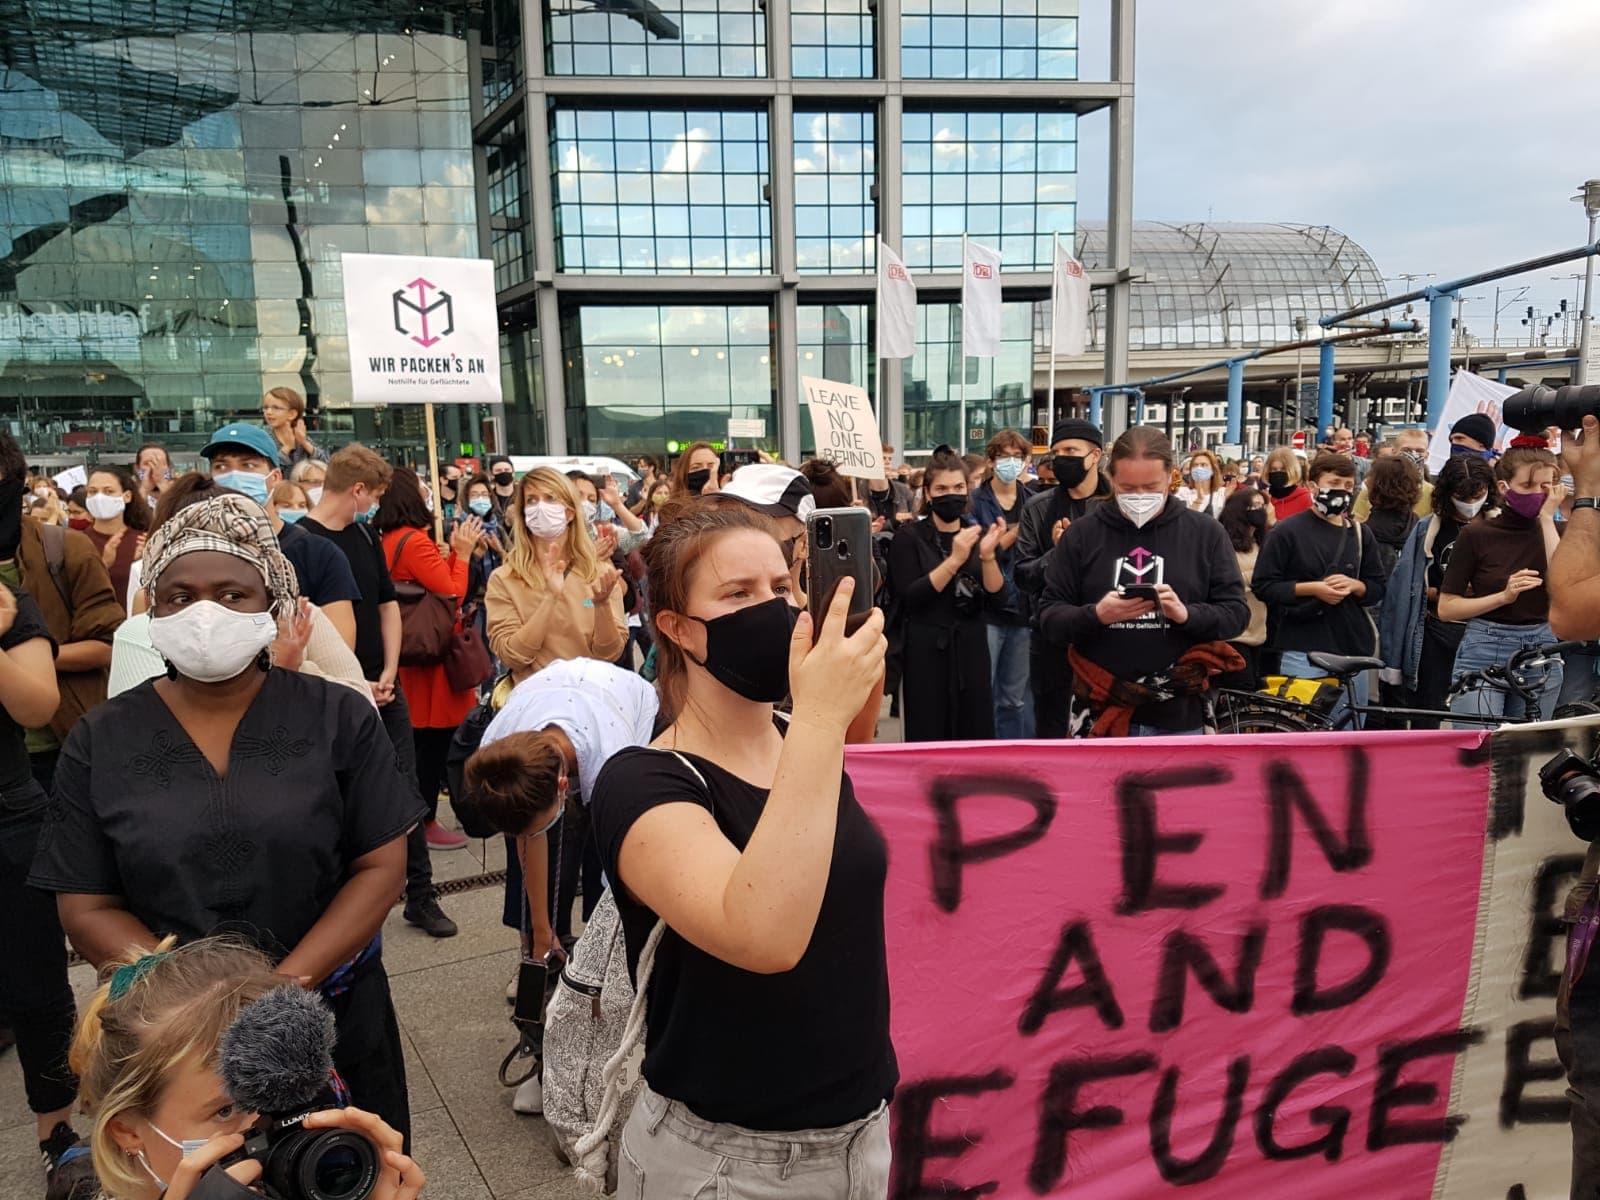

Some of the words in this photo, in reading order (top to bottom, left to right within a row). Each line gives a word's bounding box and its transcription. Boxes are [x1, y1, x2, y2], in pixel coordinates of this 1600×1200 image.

[889, 265, 906, 279] DB
[974, 264, 991, 278] DB
[369, 357, 395, 373] WIR
[400, 353, 463, 373] PACKEN'S
[468, 358, 485, 373] AN
[809, 387, 861, 410] LEAVE
[827, 409, 855, 432] NO
[830, 430, 865, 450] ONE
[823, 448, 876, 468] BEHIND
[926, 746, 1375, 914] PEN
[1018, 905, 1393, 1035] AND
[281, 1112, 310, 1127] LUMIX
